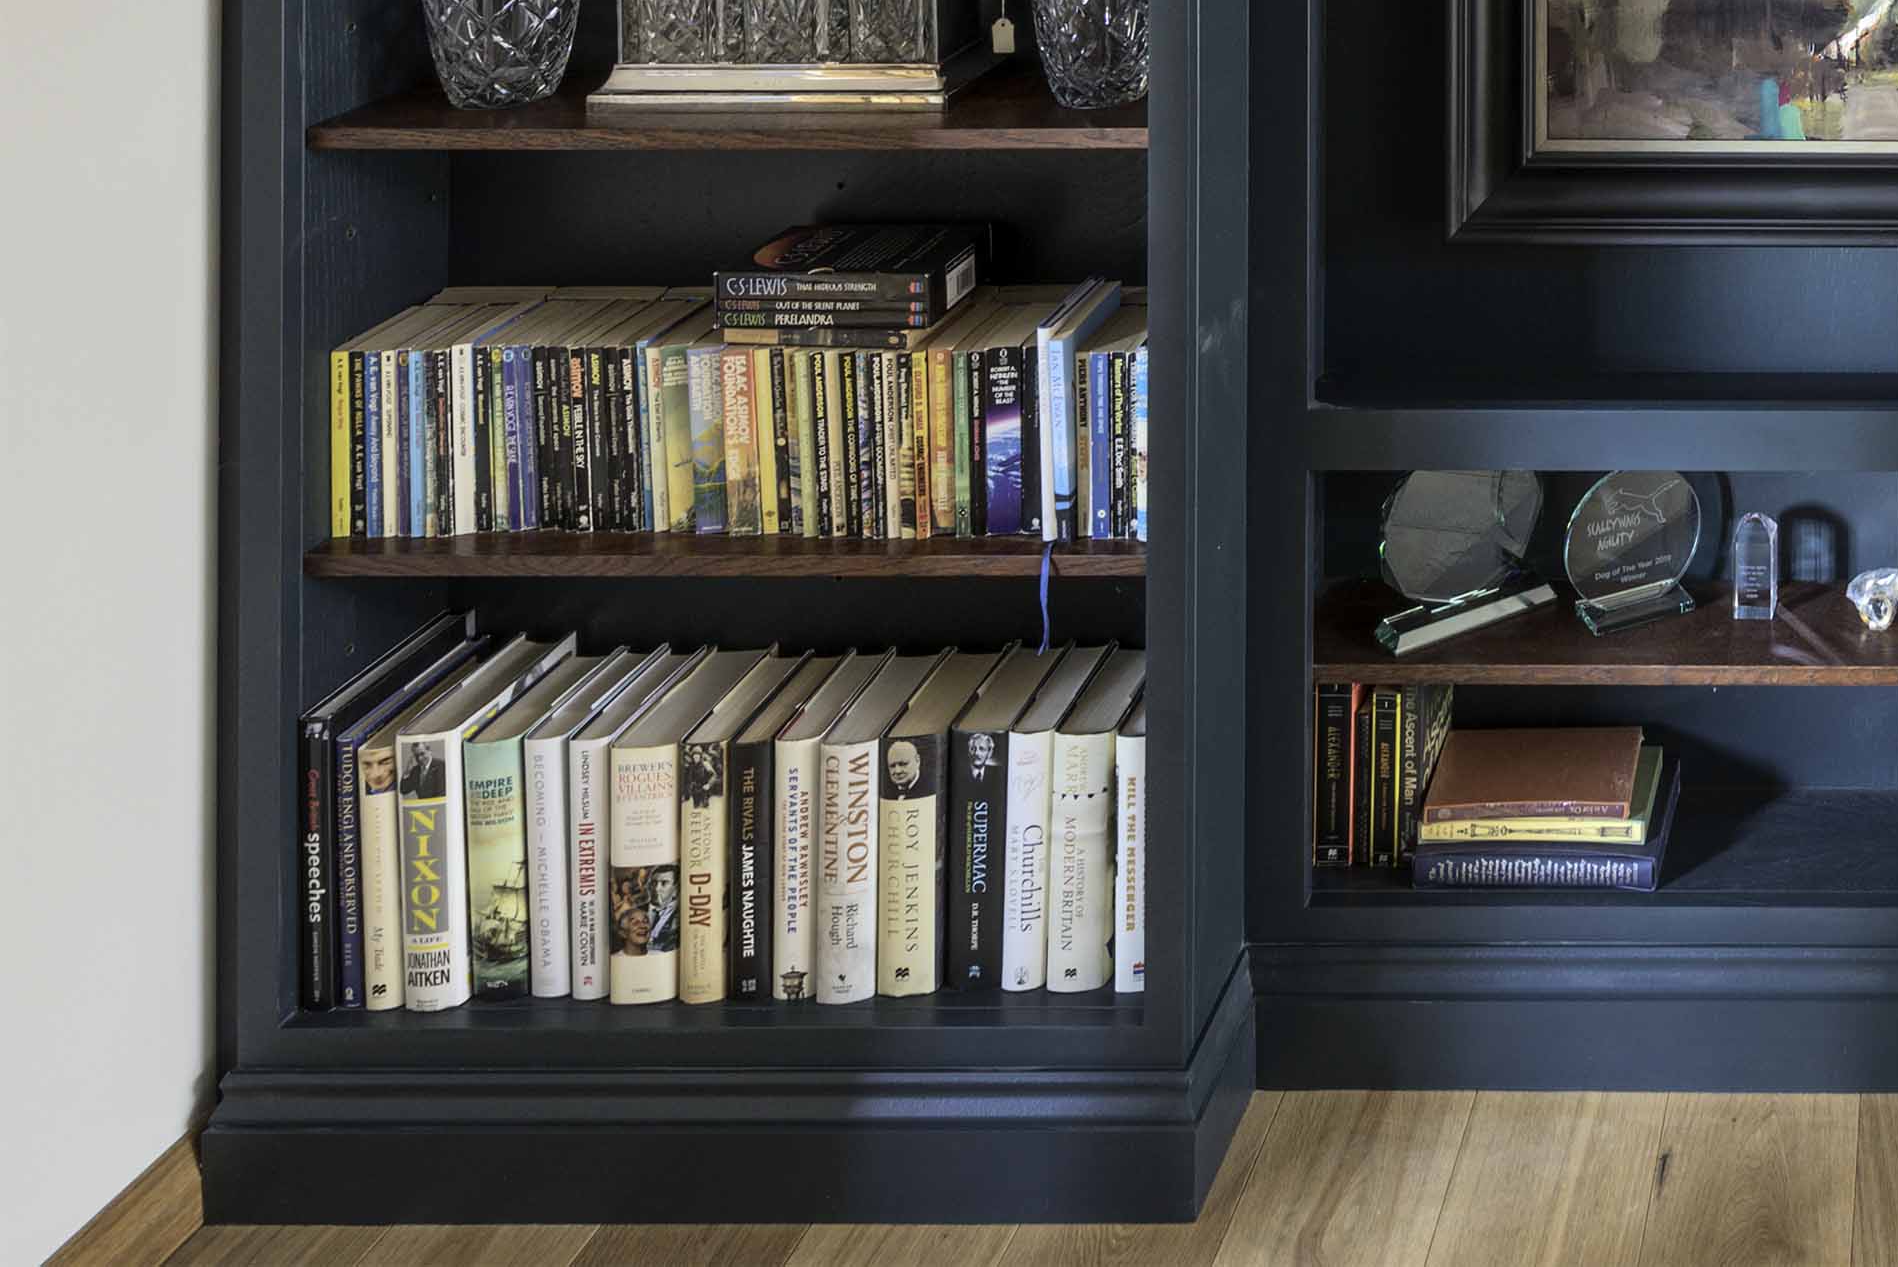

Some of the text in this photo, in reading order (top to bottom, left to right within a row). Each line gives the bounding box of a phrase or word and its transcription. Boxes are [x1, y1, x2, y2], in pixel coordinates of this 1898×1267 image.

[775, 313, 834, 326] PERELANDRA
[1595, 572, 1611, 582] Dog
[1597, 530, 1634, 551] AGILITY
[1404, 712, 1418, 806] Ascent of Man
[579, 822, 596, 897] IN EXTREMIS
[788, 768, 799, 934] SERVANTS OF THE PEOPLE
[823, 755, 840, 884] CLEMENTINE
[846, 752, 870, 885] WINSTON
[970, 800, 989, 894] SUPERMAC
[1126, 776, 1138, 932] KILL THE MESSENGER
[305, 832, 326, 923] speeches
[408, 809, 441, 932] NIXON
[537, 846, 554, 968] MICHELLE OBAMA
[689, 873, 712, 927] D-DAY
[742, 844, 756, 957] JAMES NAUGHTIE
[902, 808, 920, 952] ROY JENKINS
[1020, 824, 1044, 933] Churchills
[408, 950, 451, 970] JONATHAN
[829, 905, 843, 946] Hough
[845, 903, 859, 949] Richard
[408, 969, 451, 988] AITKEN
